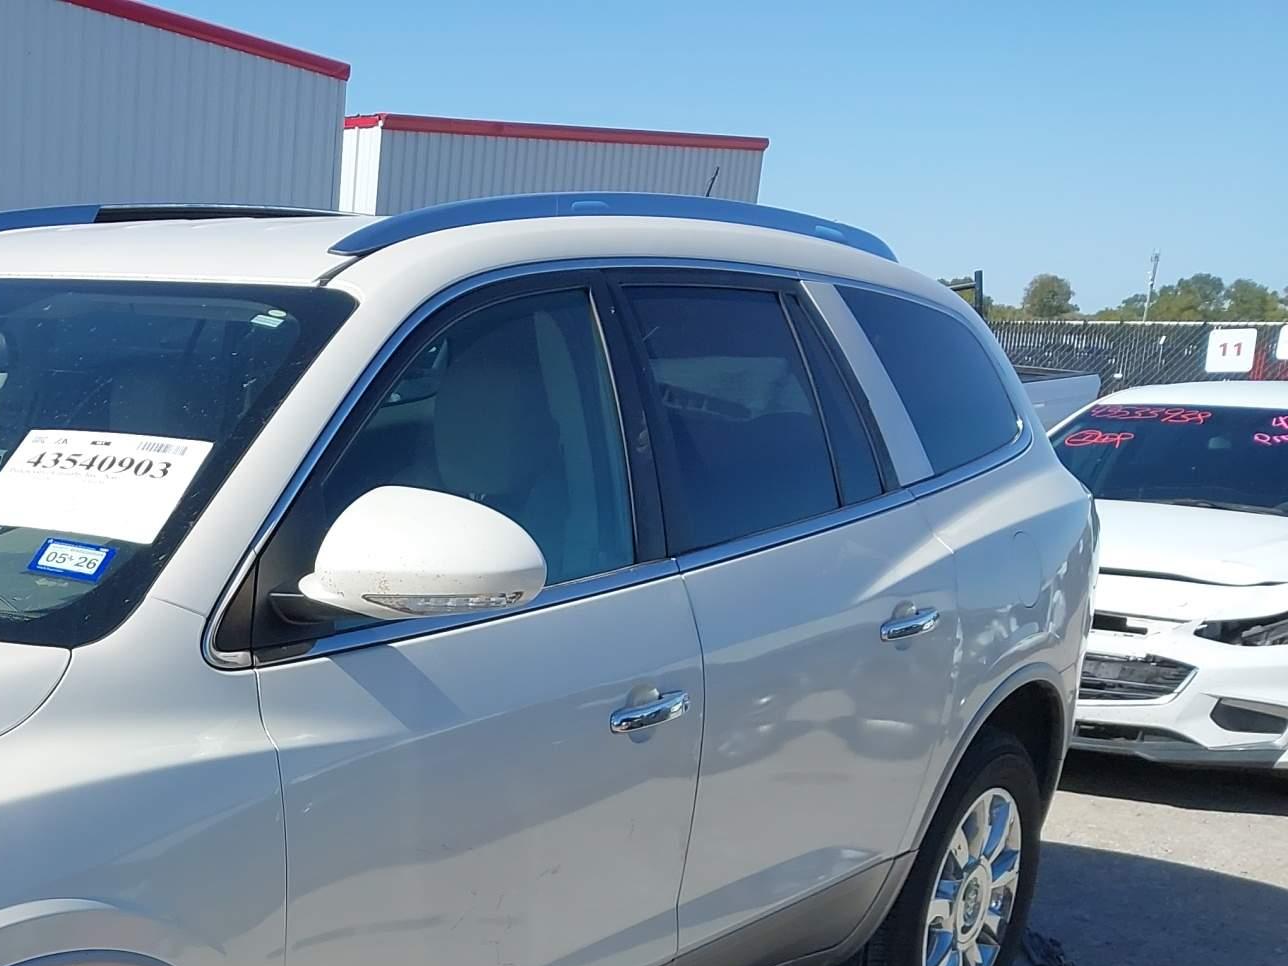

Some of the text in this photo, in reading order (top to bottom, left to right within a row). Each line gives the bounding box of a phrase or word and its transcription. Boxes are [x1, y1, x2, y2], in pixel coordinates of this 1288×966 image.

[1219, 342, 1243, 357] 11
[26, 451, 172, 479] 43540903
[45, 551, 69, 564] 05
[74, 556, 99, 570] 26
